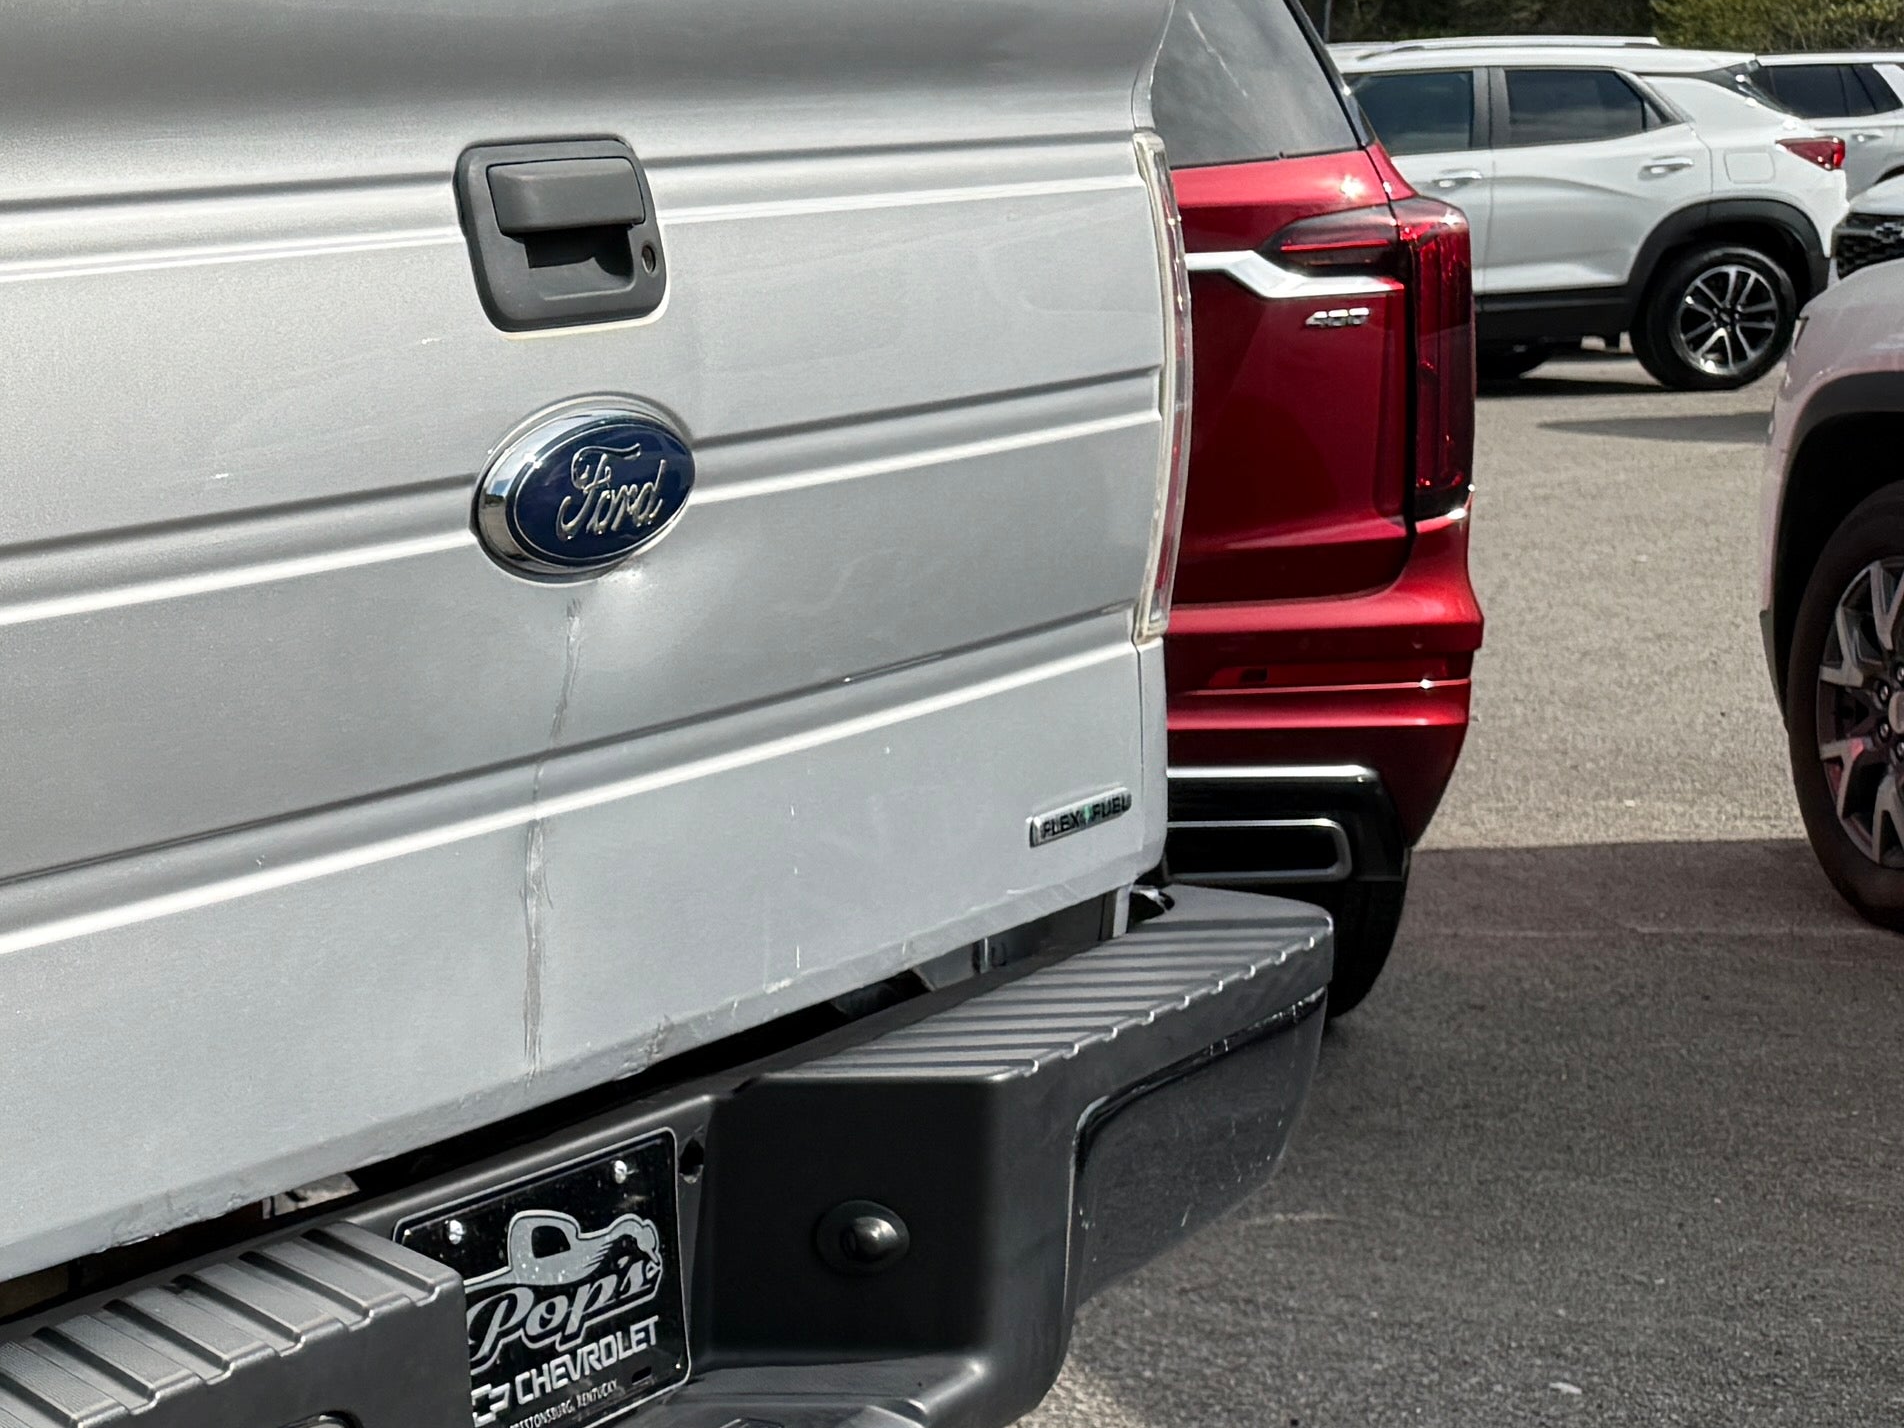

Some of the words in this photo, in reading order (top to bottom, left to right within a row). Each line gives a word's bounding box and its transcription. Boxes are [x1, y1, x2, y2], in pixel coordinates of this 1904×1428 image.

[555, 443, 667, 541] Ford
[1042, 810, 1080, 839] FLEX
[1091, 794, 1131, 822] FUEL
[467, 1255, 653, 1365] Pop's
[515, 1315, 659, 1405] CHEVROLET
[576, 1378, 617, 1408] KENTUCKY
